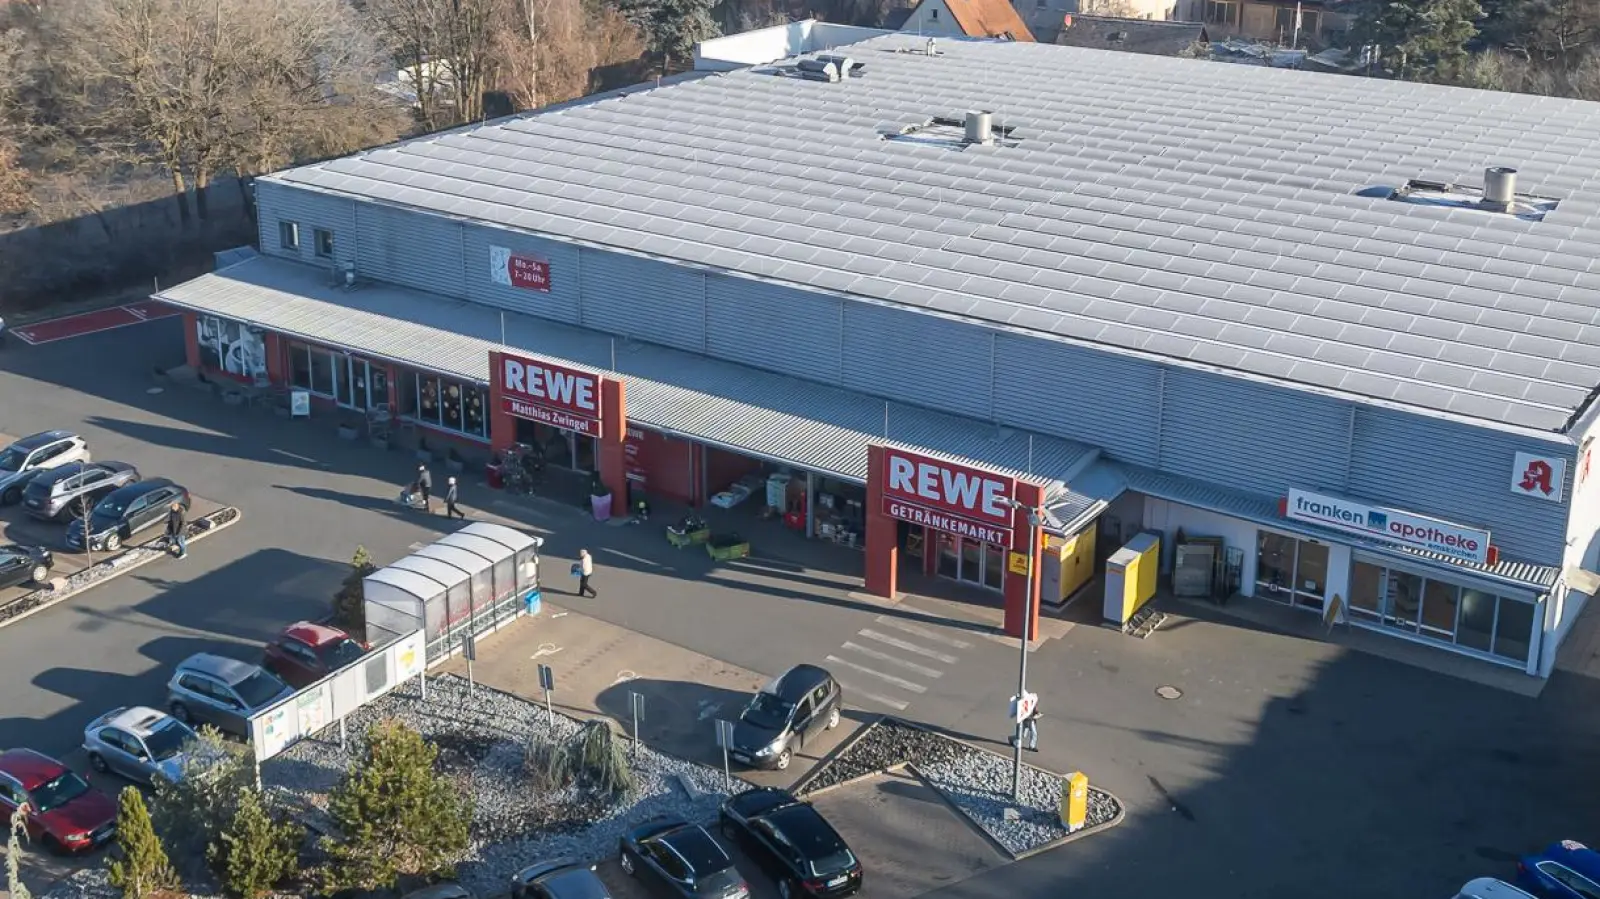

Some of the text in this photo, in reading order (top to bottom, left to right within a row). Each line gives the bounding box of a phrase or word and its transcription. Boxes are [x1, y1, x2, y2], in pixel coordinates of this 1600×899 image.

[505, 359, 594, 410] REWE
[512, 402, 589, 431] Matthias Zwingel
[889, 455, 1005, 518] REWE
[890, 503, 1004, 544] GETRÄNKEMARKT
[1297, 496, 1478, 551] franken apotheke
[1427, 543, 1478, 560] emskirchen
